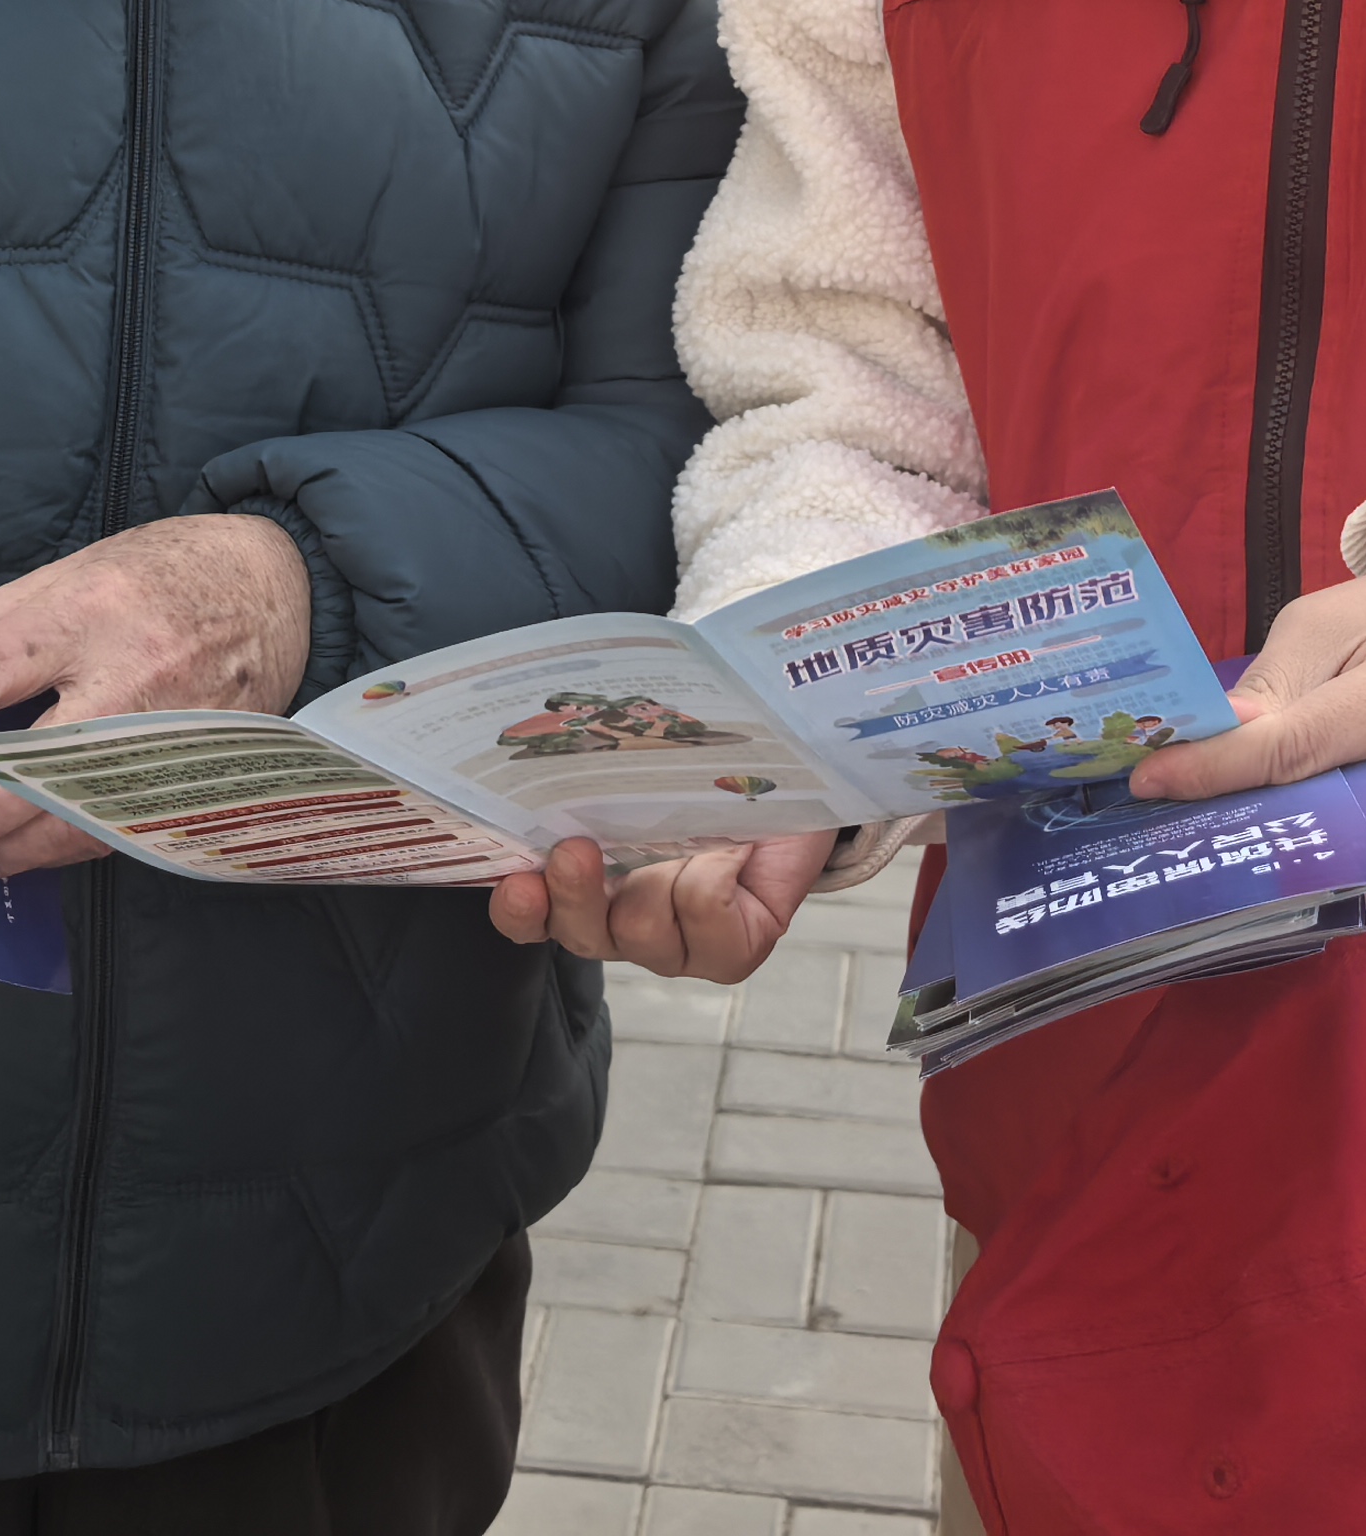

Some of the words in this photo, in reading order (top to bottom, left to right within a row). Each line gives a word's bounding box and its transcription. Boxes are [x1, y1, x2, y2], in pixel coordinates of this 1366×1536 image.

[782, 585, 931, 641] 学习防灾减灾
[933, 544, 1088, 593] 守护美好家园
[784, 568, 1139, 690] 地质灾害防范
[893, 692, 999, 729] 防灾减灾
[1009, 665, 1113, 701] 人人有责
[932, 648, 1034, 685] 宣传册
[995, 811, 1316, 914] 公民人人有责
[995, 828, 1329, 936] 共筑保密防线
